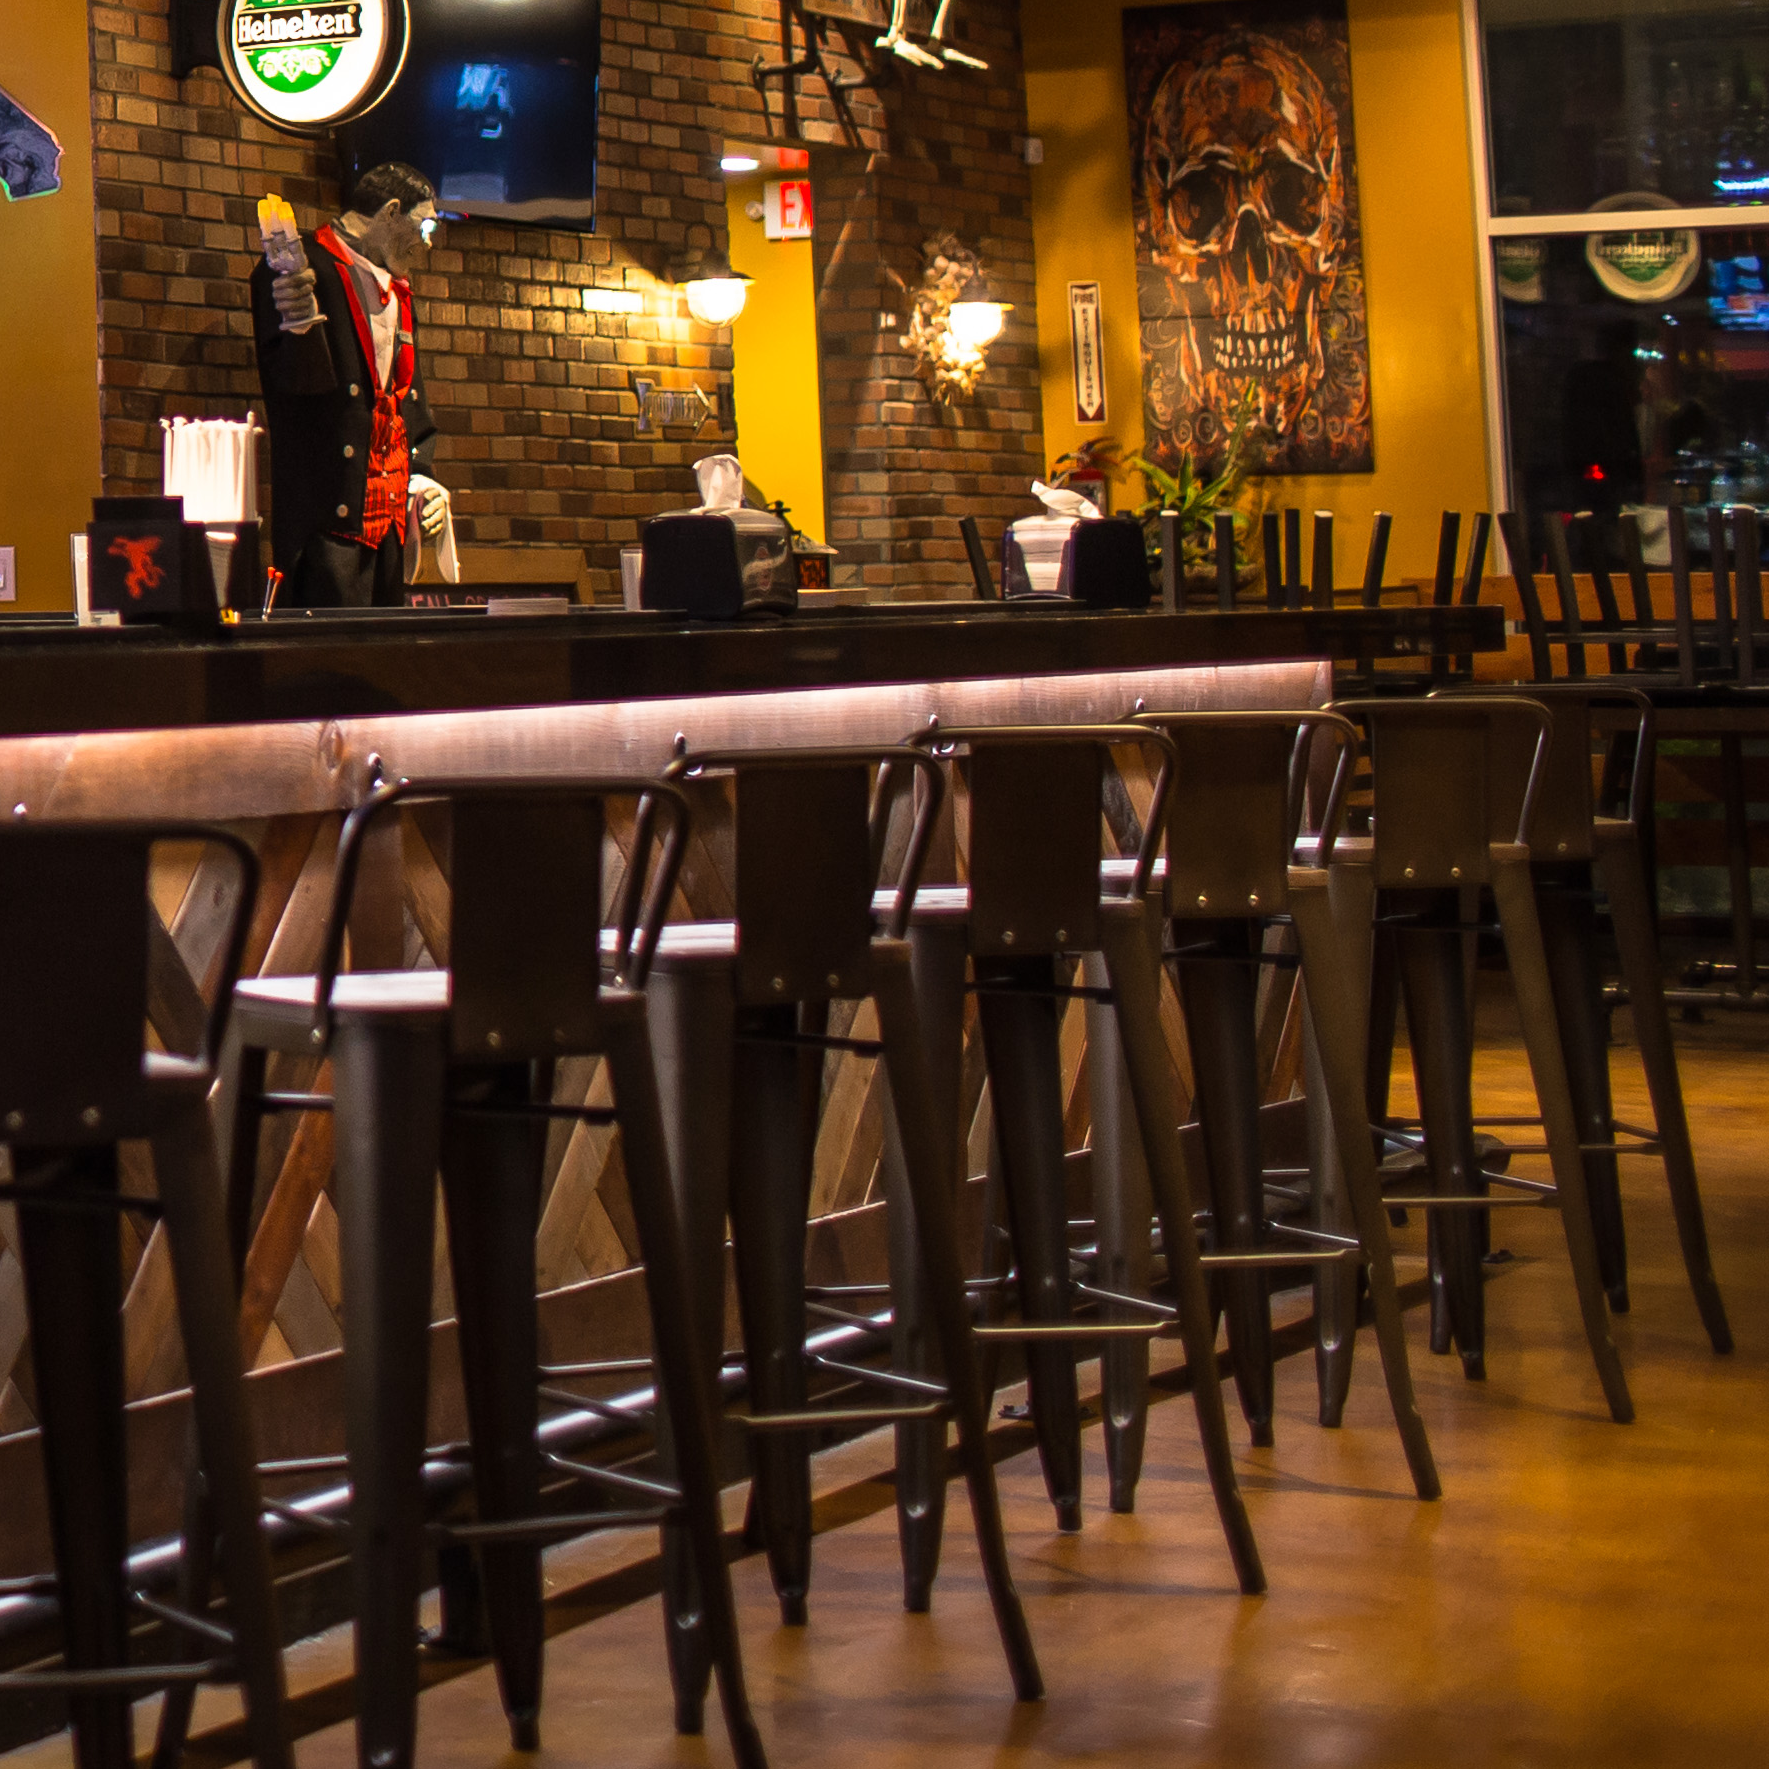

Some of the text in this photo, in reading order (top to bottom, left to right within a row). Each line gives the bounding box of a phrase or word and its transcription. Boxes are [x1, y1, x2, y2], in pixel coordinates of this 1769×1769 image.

[238, 10, 355, 43] Heineken
[780, 182, 813, 229] EX
[1074, 293, 1095, 304] FIRE
